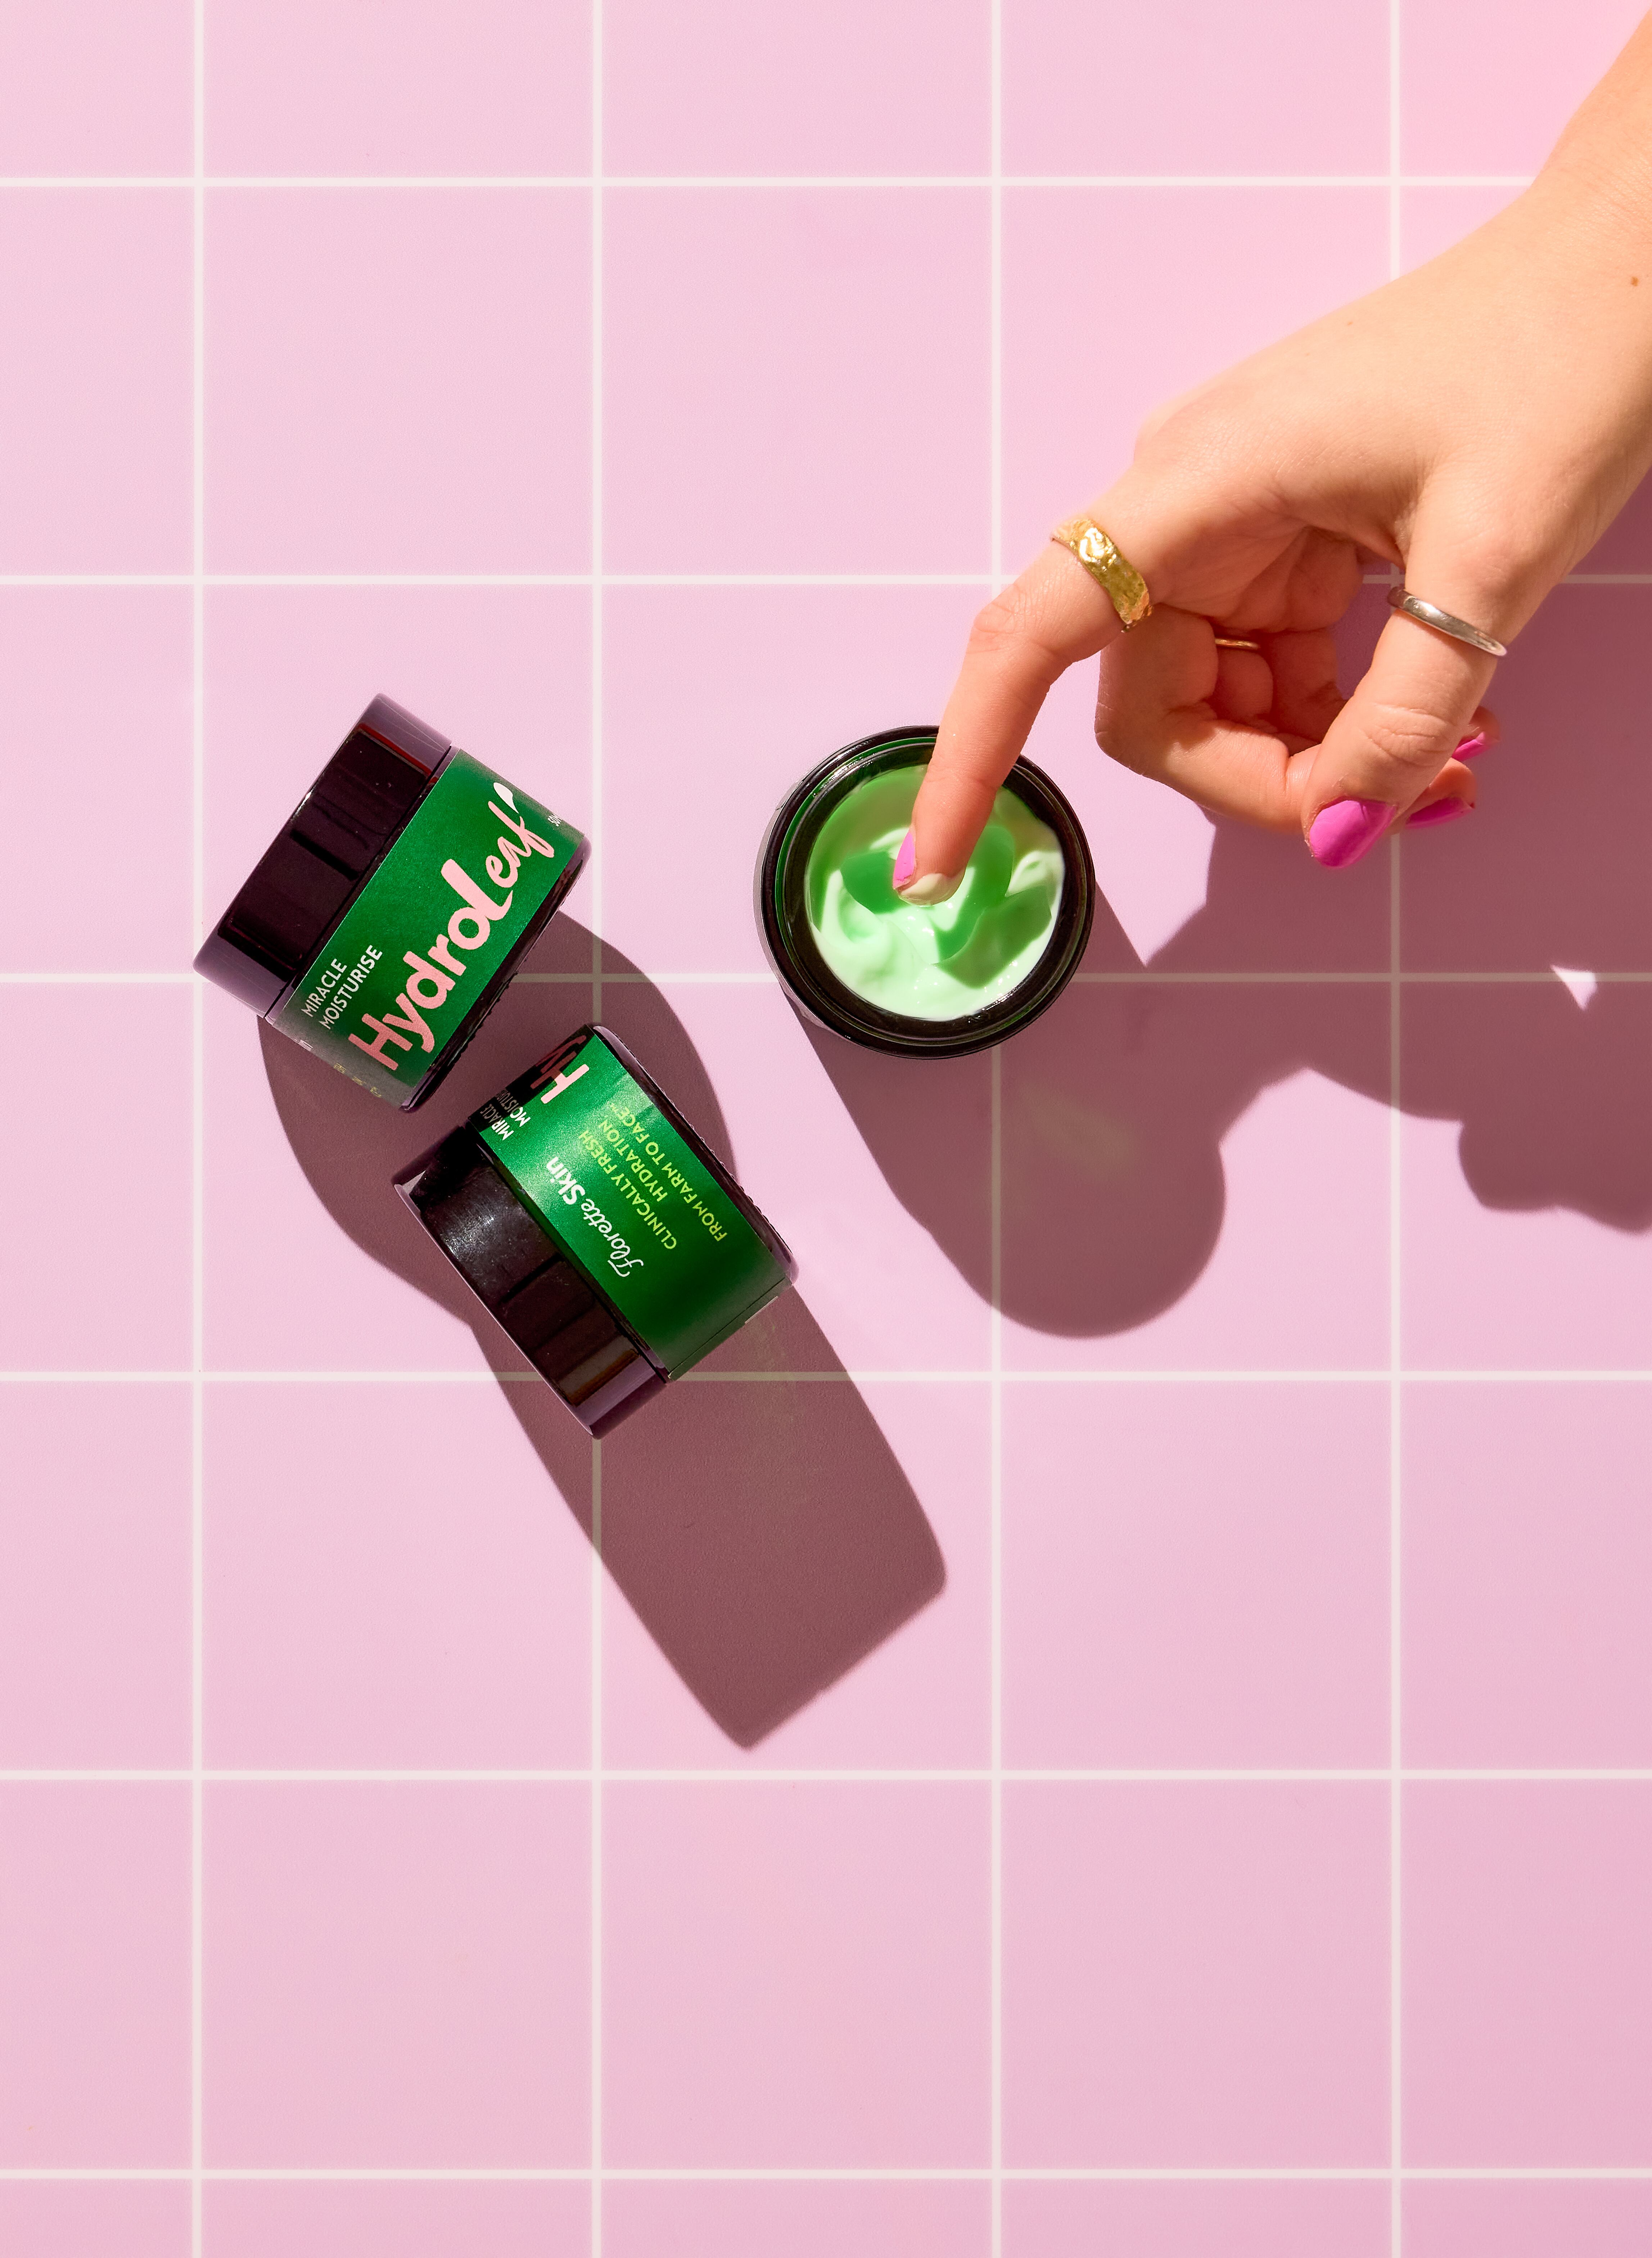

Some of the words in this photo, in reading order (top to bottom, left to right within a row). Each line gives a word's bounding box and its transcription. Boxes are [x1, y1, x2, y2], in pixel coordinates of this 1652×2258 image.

[301, 958, 347, 1017] MIRACLE
[319, 945, 383, 1029] MOISTURISE
[480, 1104, 514, 1141] MIRACLE
[578, 1130, 617, 1174] FRESH
[645, 1141, 665, 1166] TO
[546, 1156, 586, 1205] Skin
[662, 1162, 698, 1203] FARM
[611, 1173, 677, 1249] CLINICALLY
[692, 1200, 728, 1241] FROM
[581, 1198, 644, 1277] Florette
